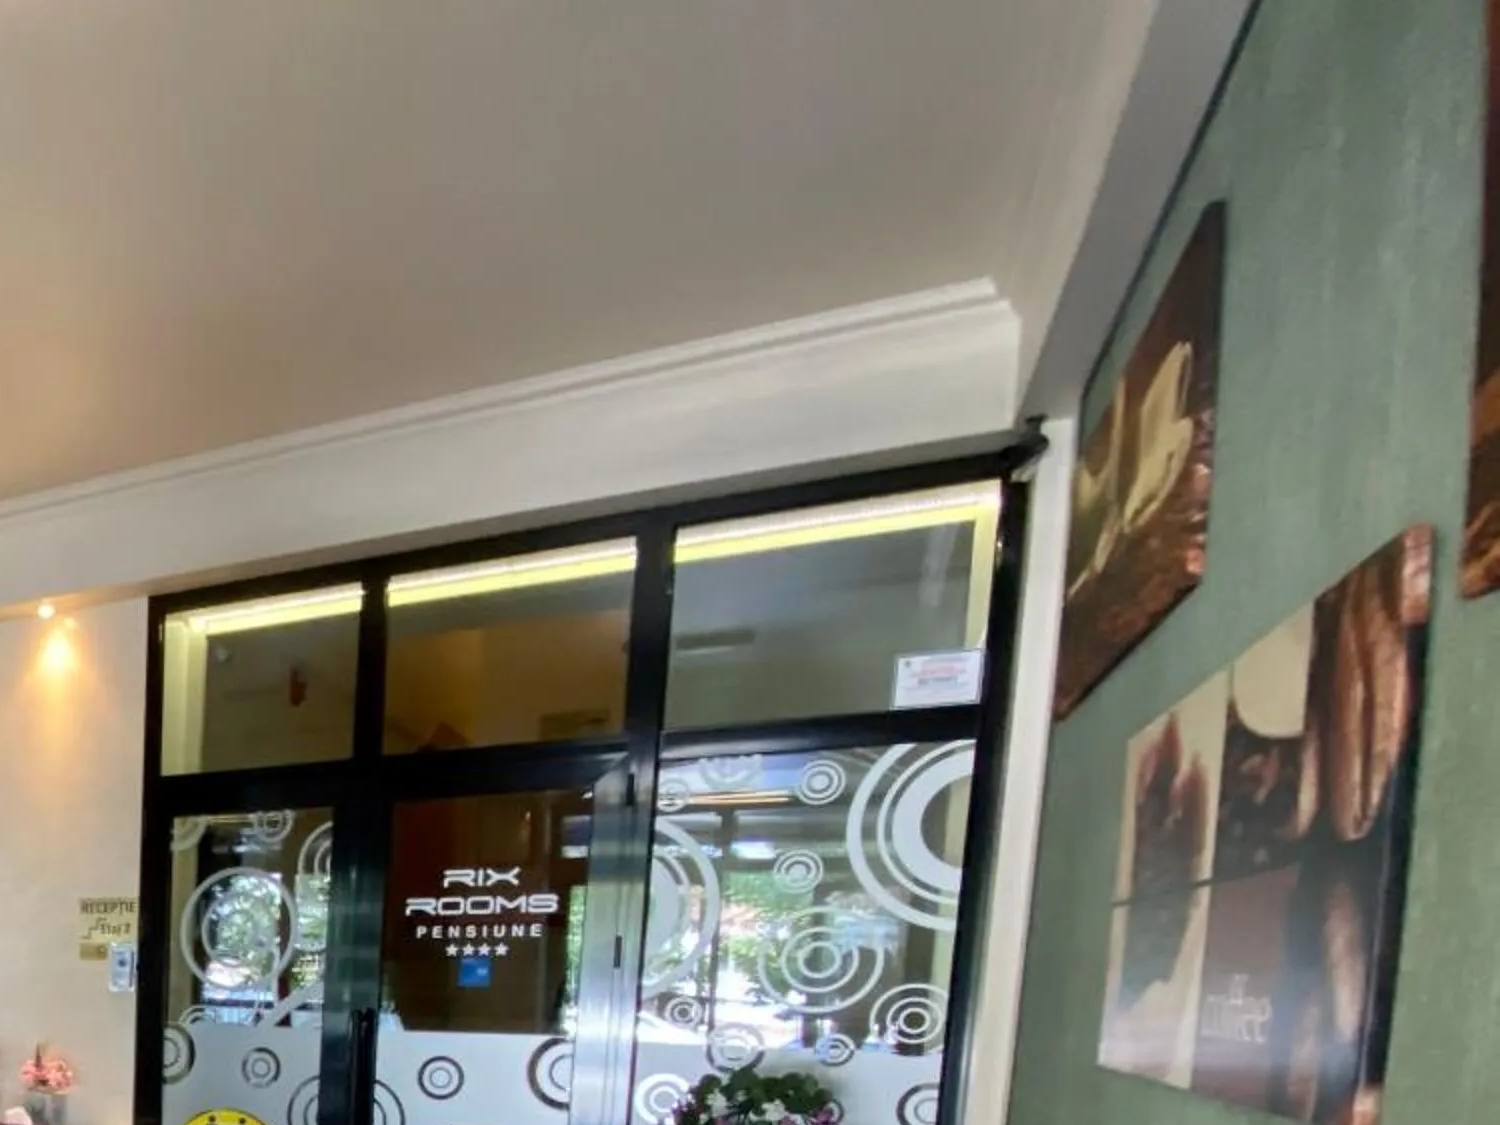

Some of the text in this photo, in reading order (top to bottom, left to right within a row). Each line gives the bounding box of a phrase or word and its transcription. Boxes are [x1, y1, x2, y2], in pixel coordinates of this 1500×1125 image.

[443, 866, 522, 888] RIX
[405, 893, 560, 916] ROOMS
[416, 923, 543, 939] PENSIUNE
